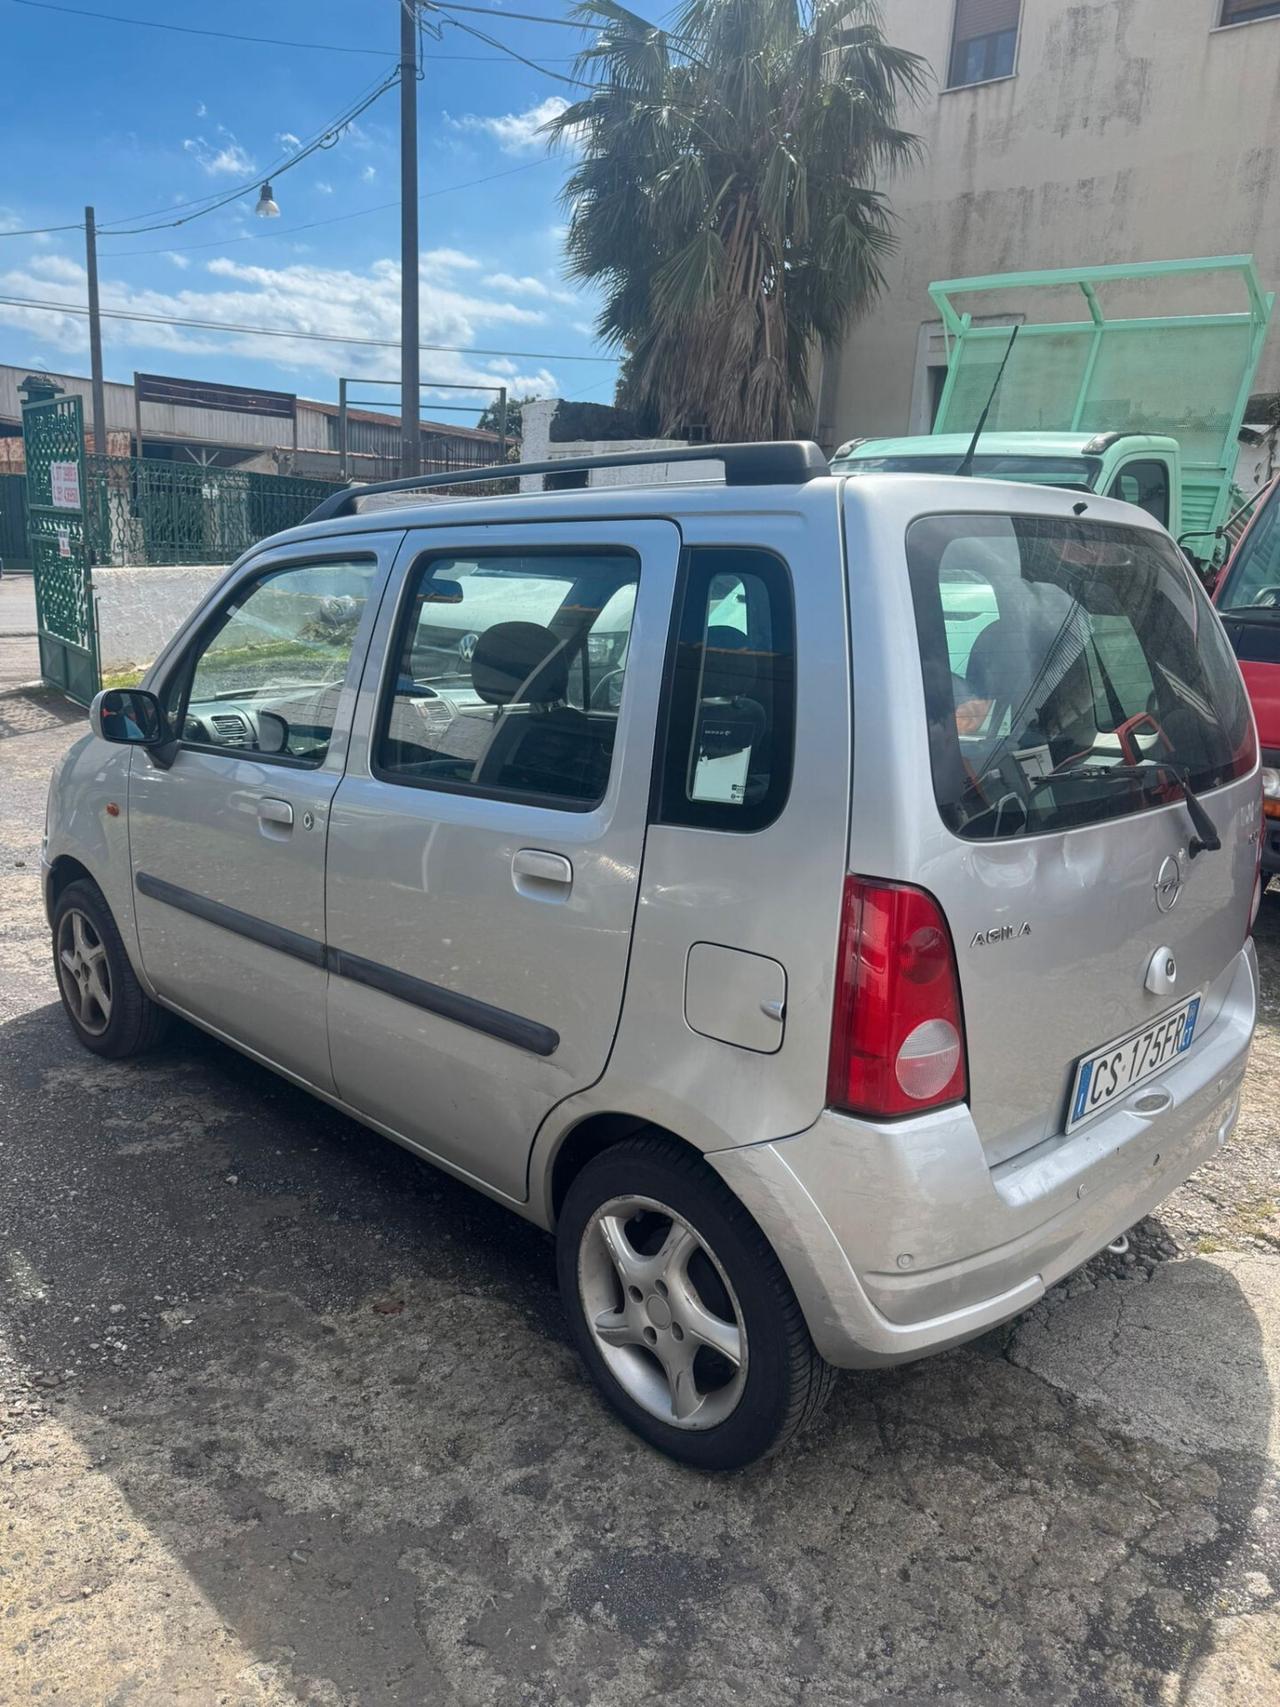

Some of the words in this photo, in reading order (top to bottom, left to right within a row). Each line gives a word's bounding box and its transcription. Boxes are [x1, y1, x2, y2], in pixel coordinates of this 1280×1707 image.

[969, 920, 1031, 948] AGILA
[1090, 1052, 1123, 1105] CS
[1128, 1012, 1186, 1082] 175FR
